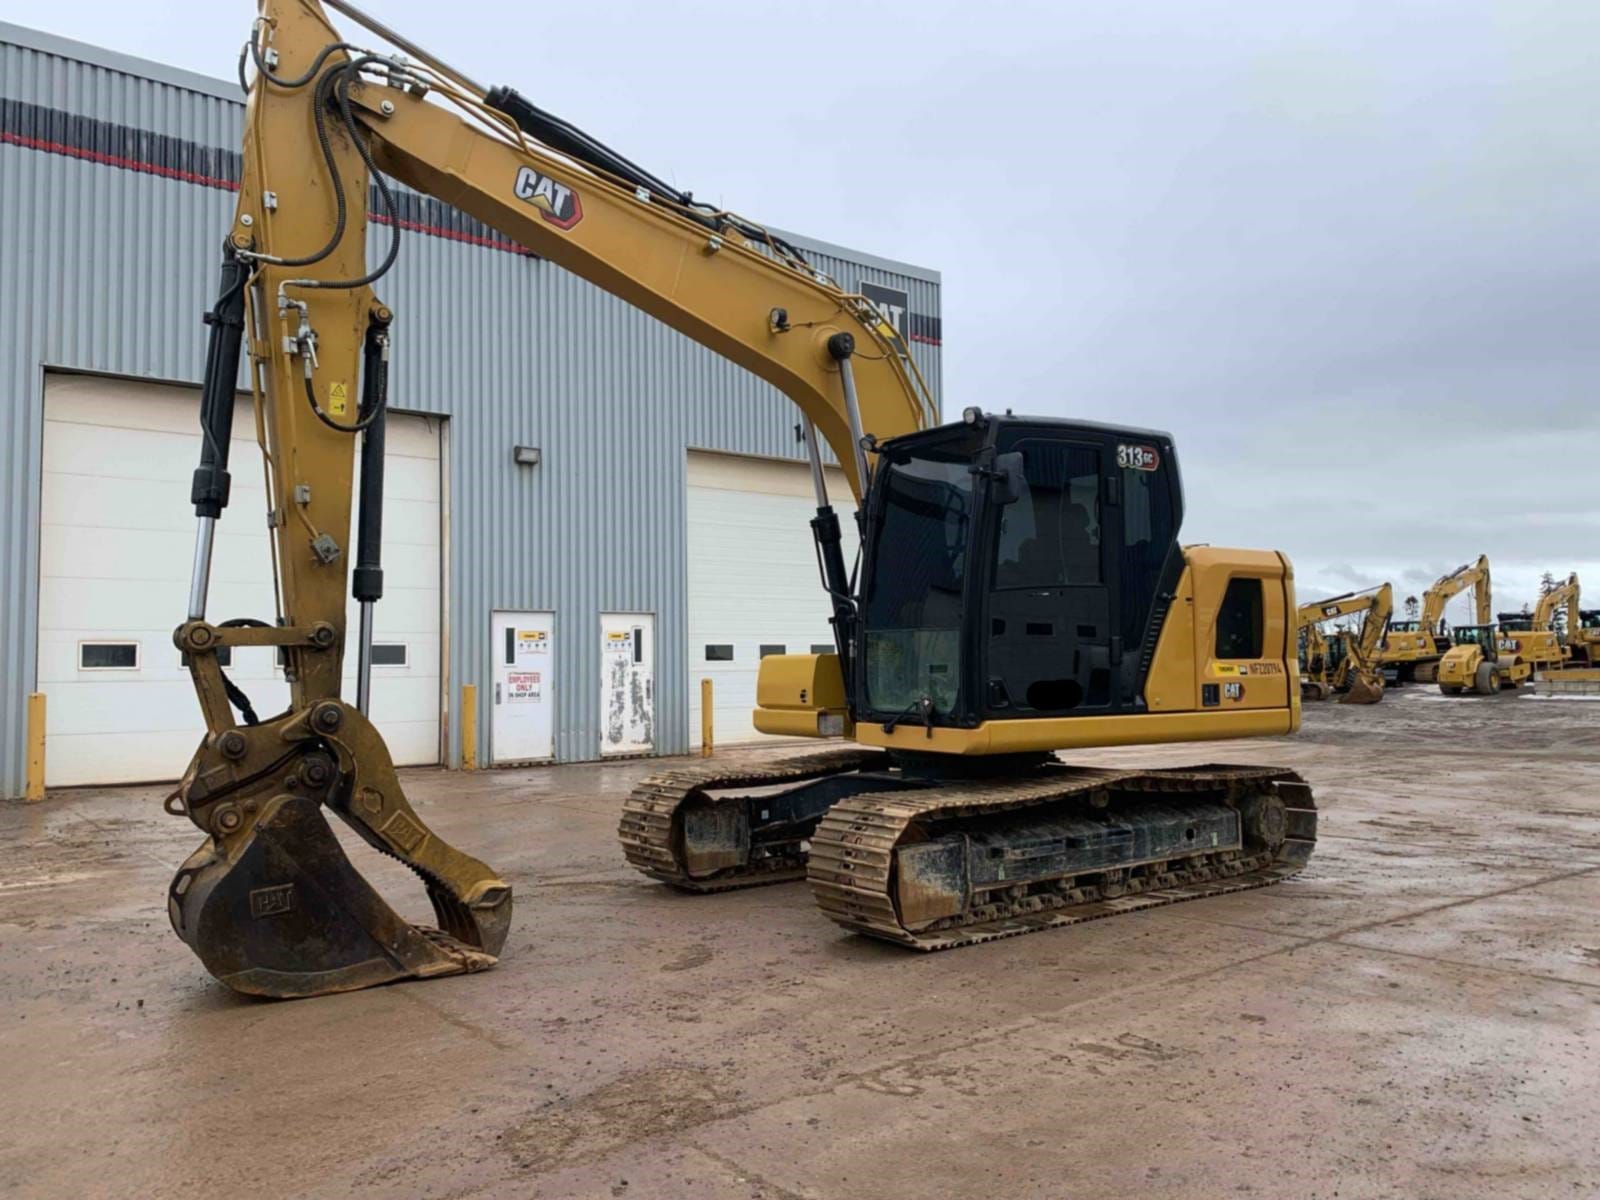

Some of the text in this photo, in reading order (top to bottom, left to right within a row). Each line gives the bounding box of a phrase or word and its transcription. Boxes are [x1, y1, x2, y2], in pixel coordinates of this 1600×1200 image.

[514, 166, 572, 217] CAT
[1117, 445, 1143, 467] 313
[1498, 639, 1517, 651] CAT
[508, 675, 540, 684] EMPLOYEES
[516, 684, 532, 692] ONLY
[1224, 683, 1240, 698] CAT
